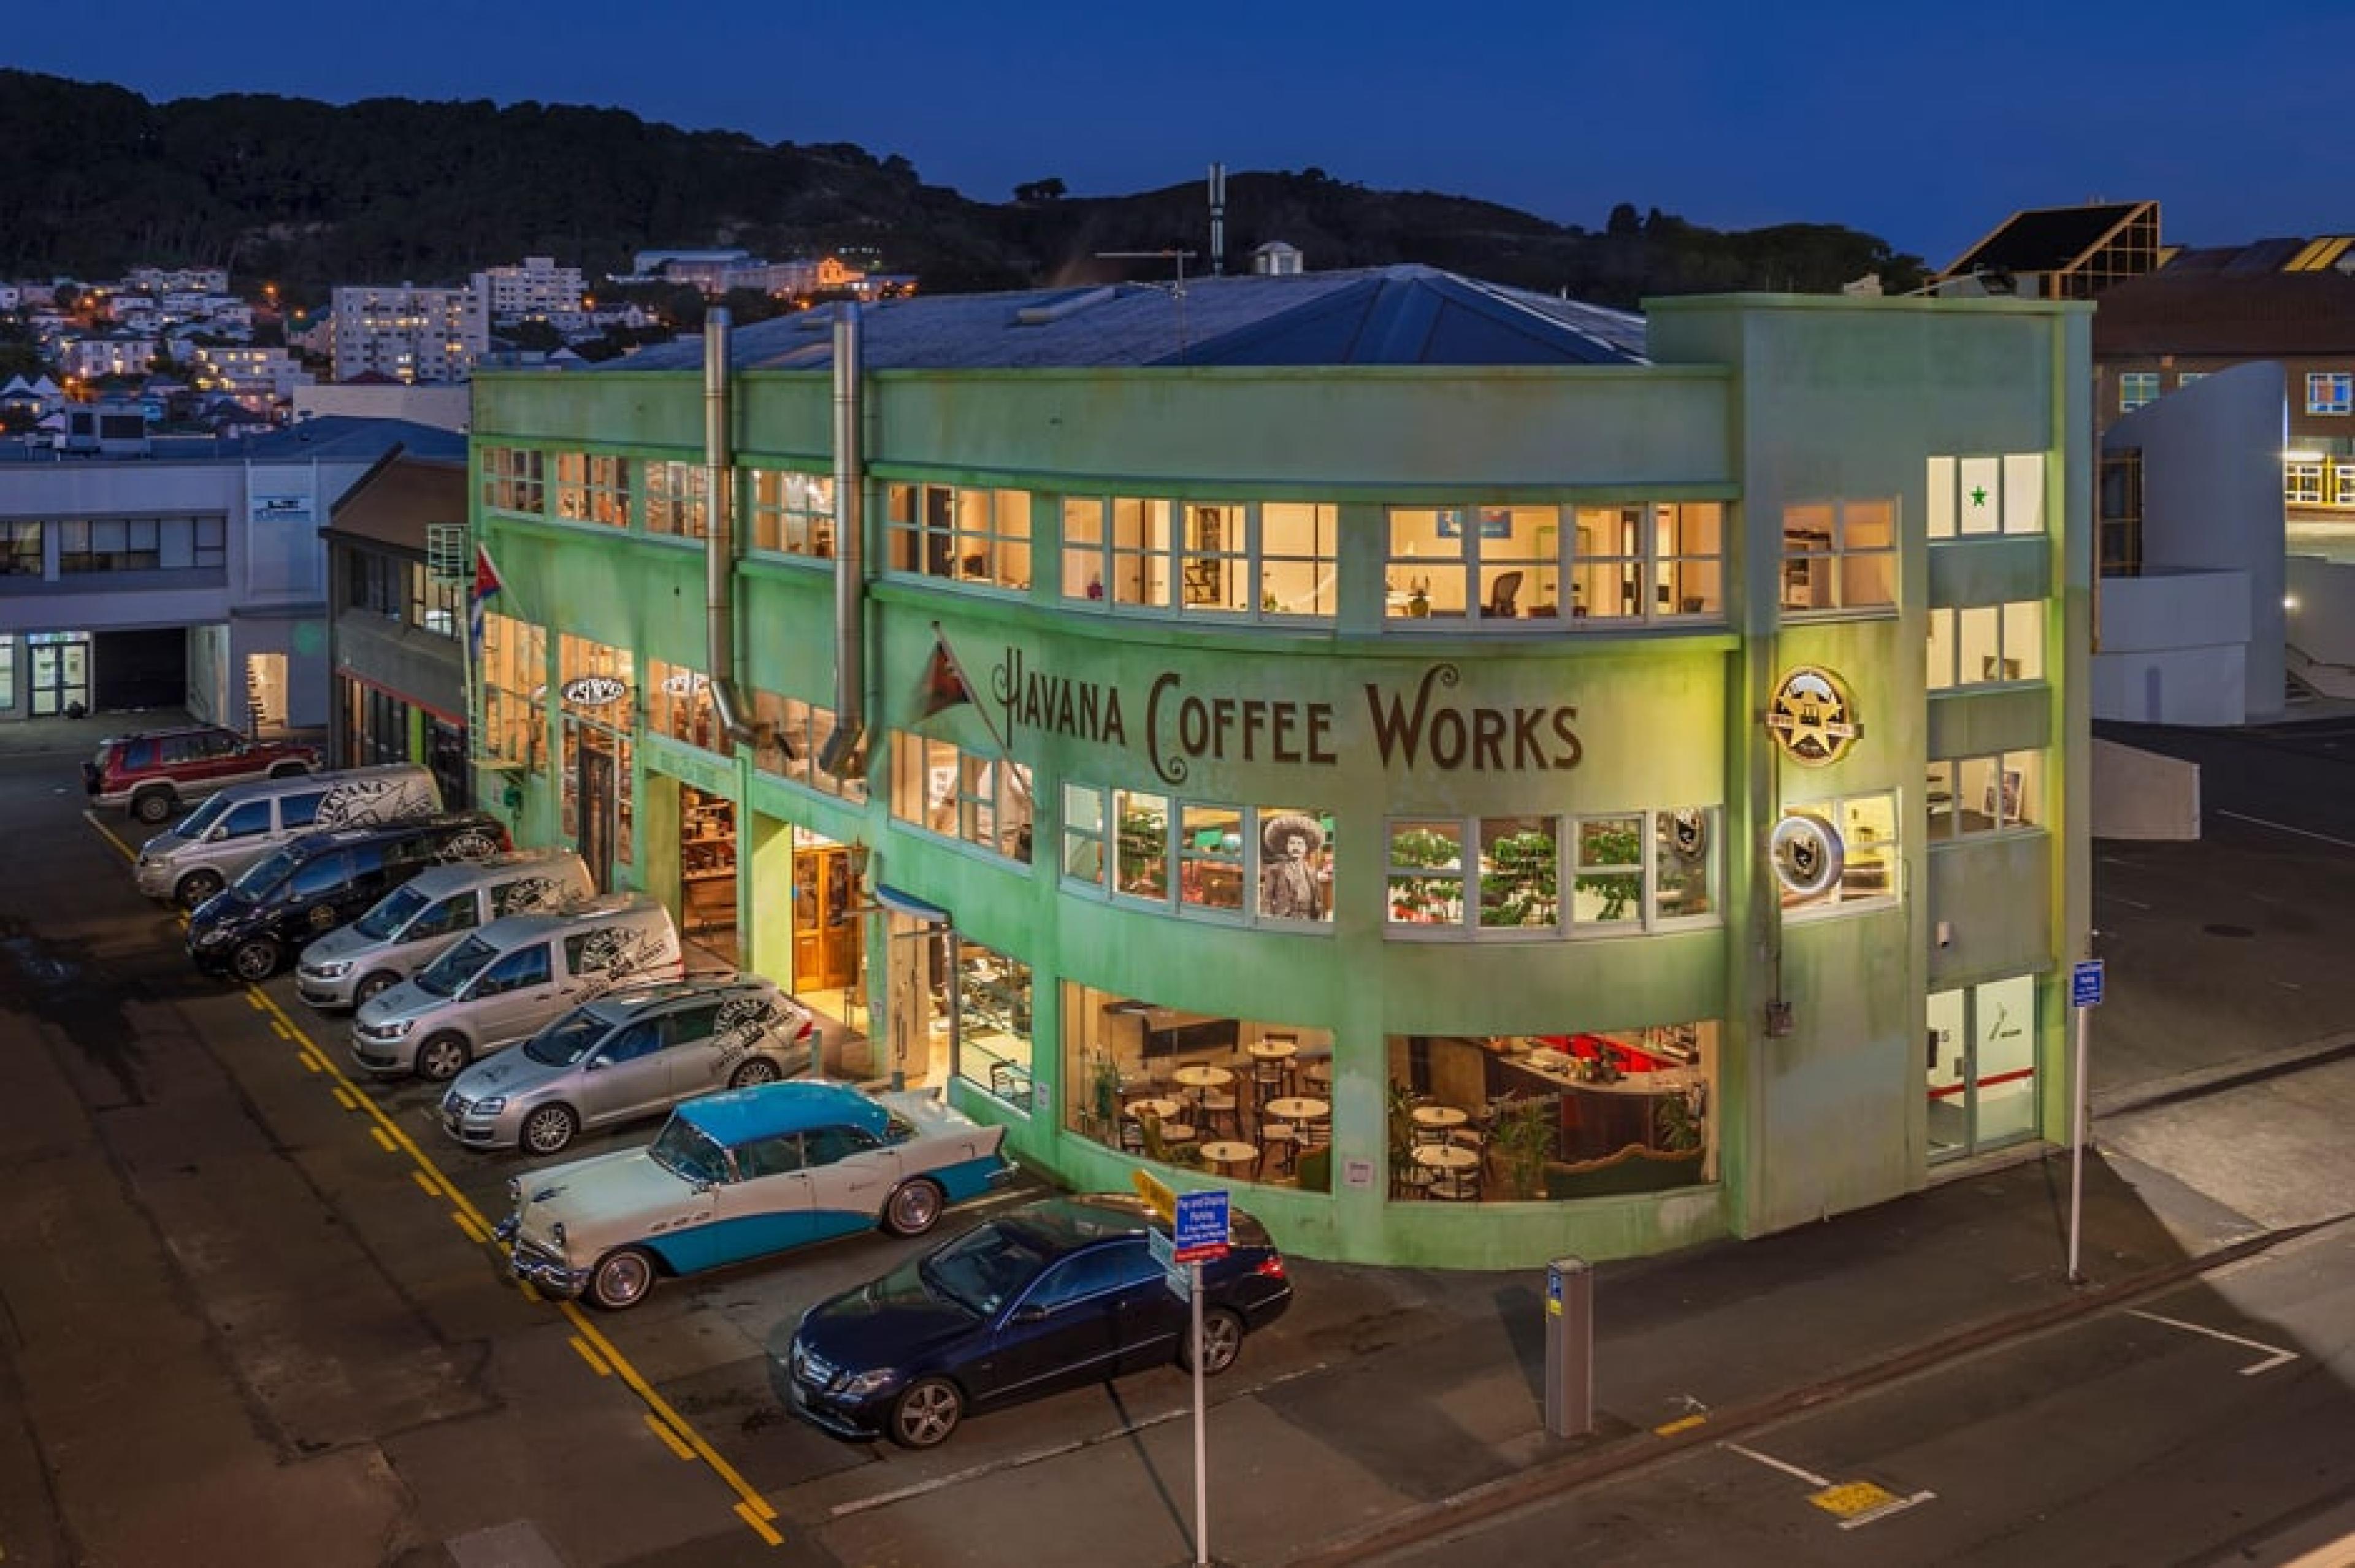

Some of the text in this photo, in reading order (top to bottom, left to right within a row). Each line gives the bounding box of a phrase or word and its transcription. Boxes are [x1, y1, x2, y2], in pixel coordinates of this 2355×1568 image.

[992, 646, 1583, 786] HAVANA COFFEE WORKS
